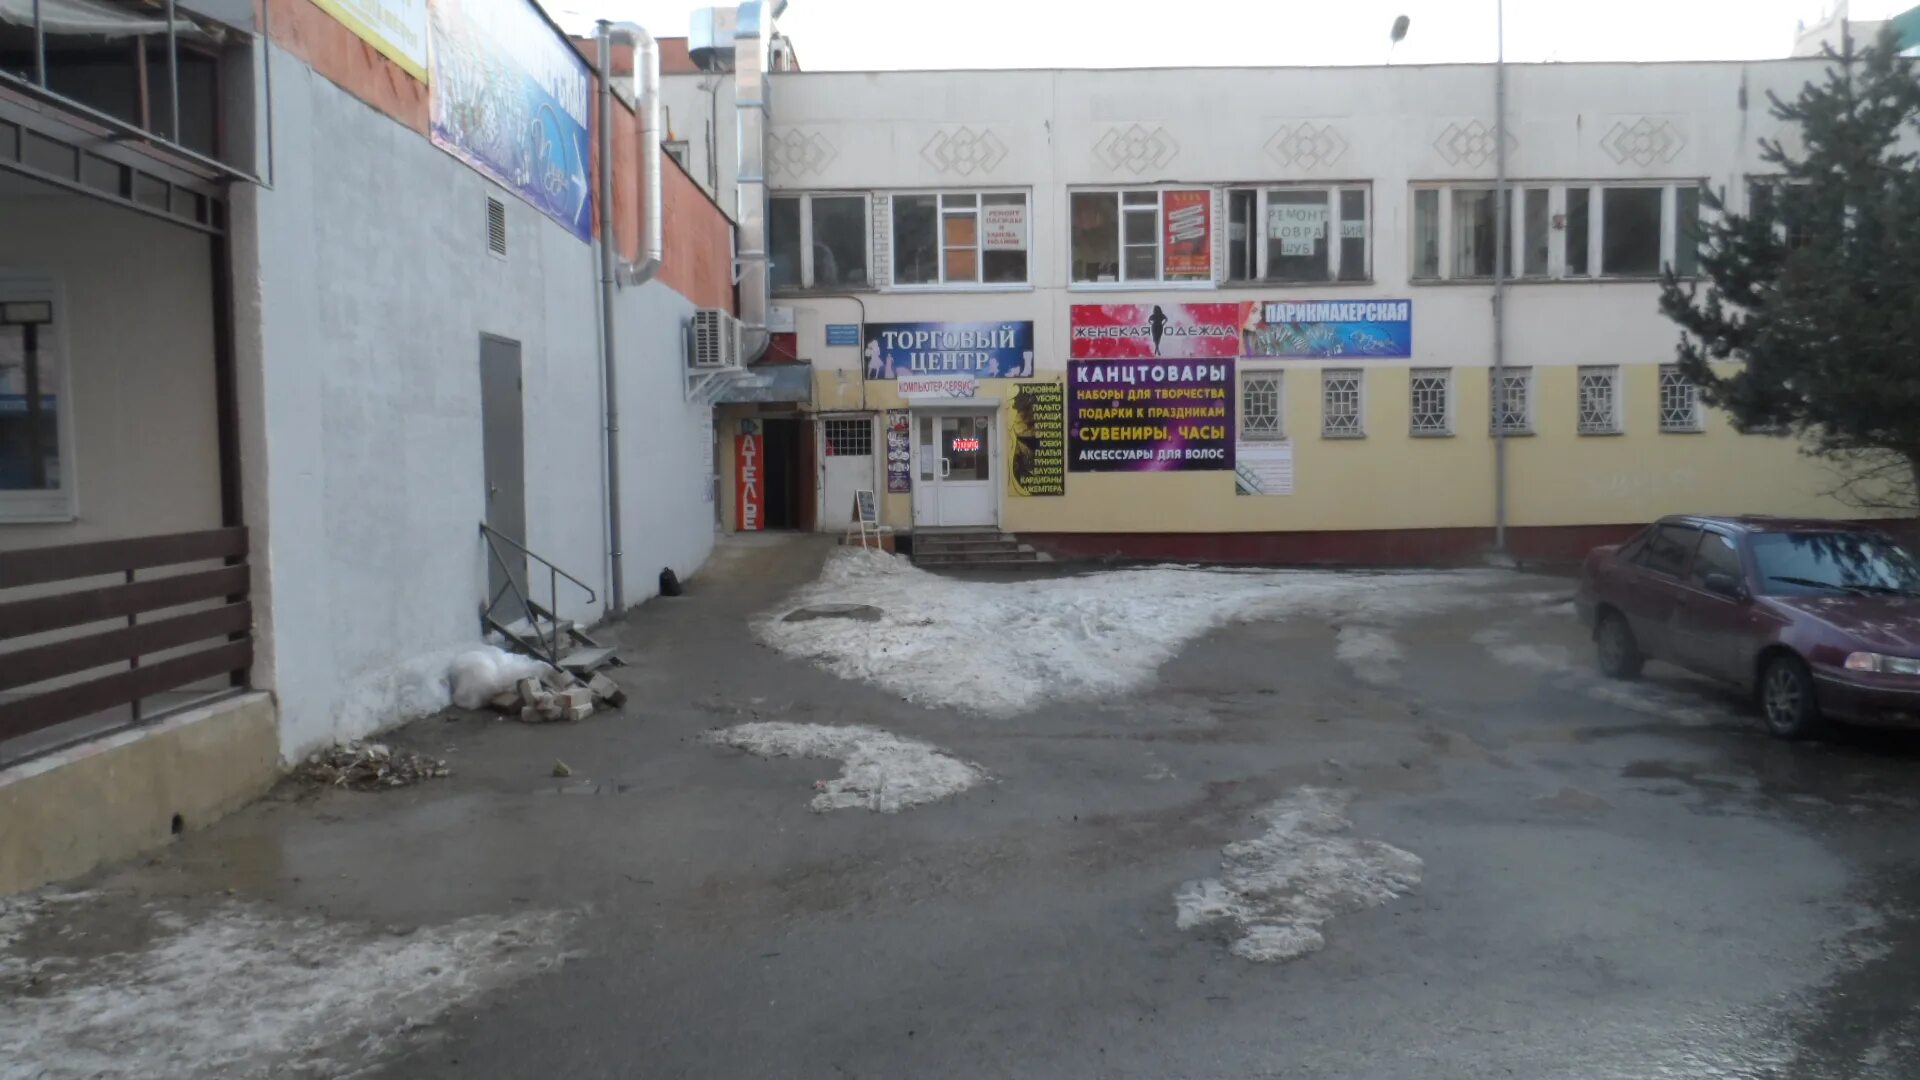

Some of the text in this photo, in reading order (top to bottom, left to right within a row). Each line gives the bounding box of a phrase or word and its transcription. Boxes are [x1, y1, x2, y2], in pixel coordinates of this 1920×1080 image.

[1268, 209, 1328, 222] РЕМОНТ
[1264, 302, 1409, 323] ПАРИКМАХЕРСКАЯ
[882, 325, 1016, 350] ТОРГОВЫЙ
[1073, 325, 1236, 338] ЖЕНСКАЯ ОДЕЖДА
[910, 351, 990, 374] ЦЕНТР
[1076, 365, 1226, 385] КАНЦТОВАРЫ
[1022, 385, 1061, 394] ГОЛОВНЫЕ
[1077, 388, 1225, 401] НАБОРЫ ДЛЯ ТВОРЧЕСТВА
[1036, 394, 1061, 402] УБОРЫ
[1033, 413, 1062, 421] ПЛАЩИ
[1078, 406, 1225, 420] ПОДАРКИ К ПРАЗДНИКАМ
[1079, 425, 1225, 443] СУВЕНИРЫ, ЧАСЫ
[1034, 449, 1062, 457] ПЛАТЬЯ
[1078, 448, 1225, 461] АКСЕССУАРЫ ДЛЯ ВОЛОС
[1034, 458, 1062, 466] ТУНИКИ
[742, 434, 757, 530] АТЕЛЬЕ
